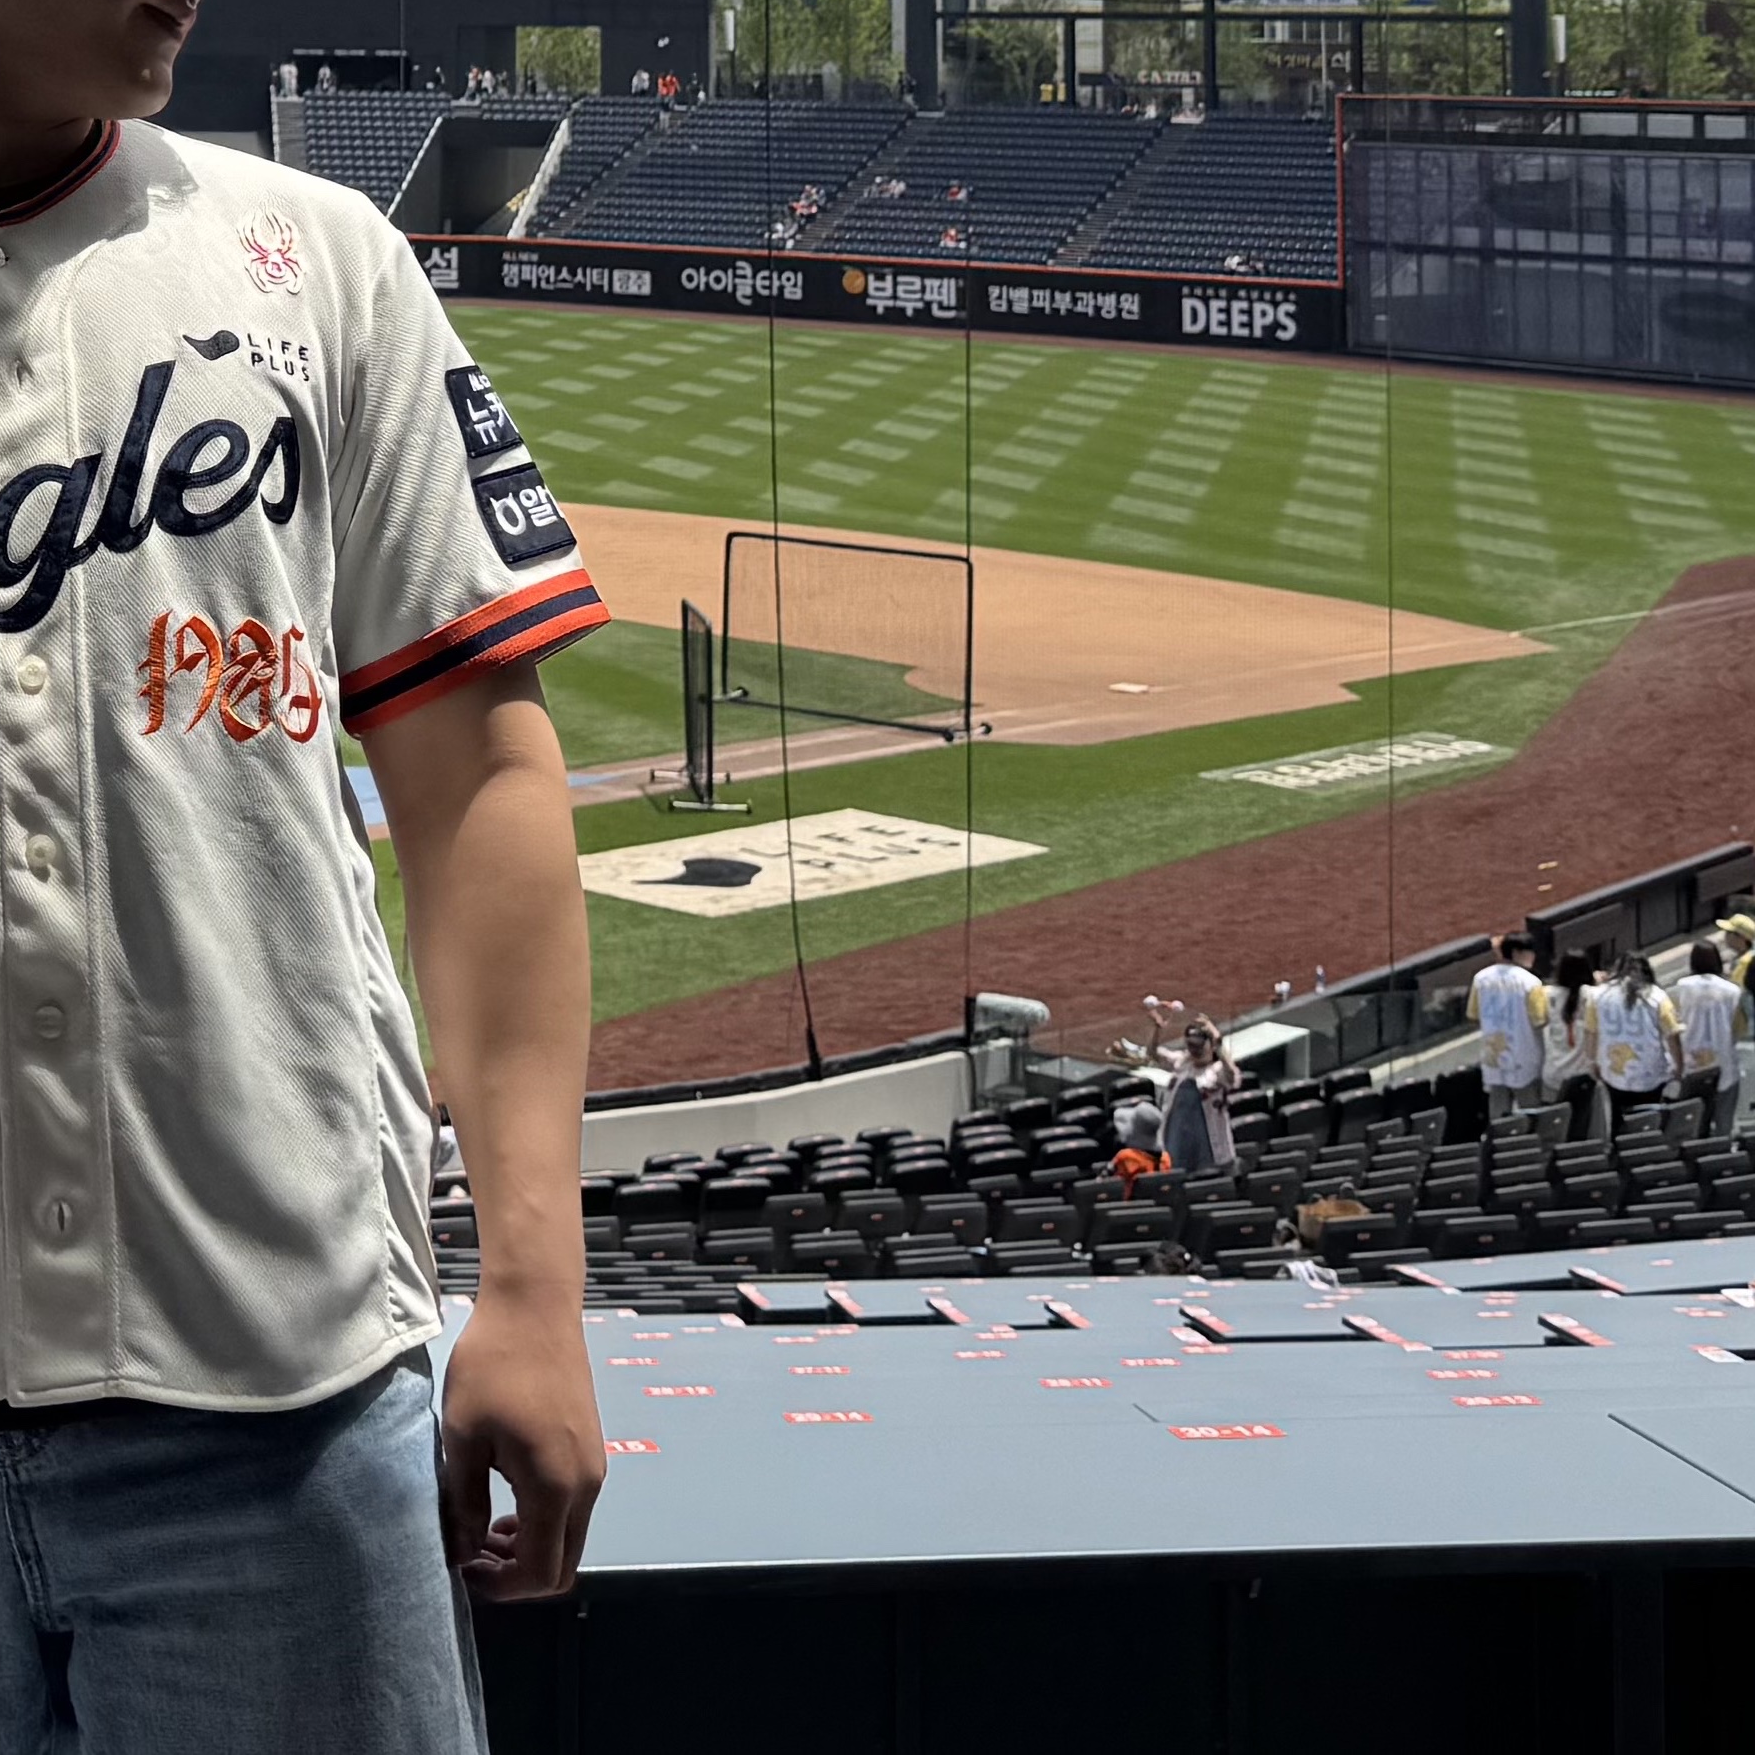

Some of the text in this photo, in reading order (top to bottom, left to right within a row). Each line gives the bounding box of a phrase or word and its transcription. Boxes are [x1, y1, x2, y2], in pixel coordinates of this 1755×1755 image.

[502, 263, 609, 294] 챔피언스시티
[680, 260, 803, 306] 아이클타임
[865, 272, 958, 319] 부루펜
[1181, 297, 1297, 341] DEEPS
[247, 332, 310, 359] LIFE
[250, 351, 313, 384] PLUS
[740, 825, 907, 858] LIFE
[797, 836, 962, 871] PLUS
[1178, 1425, 1272, 1439] 30-14
